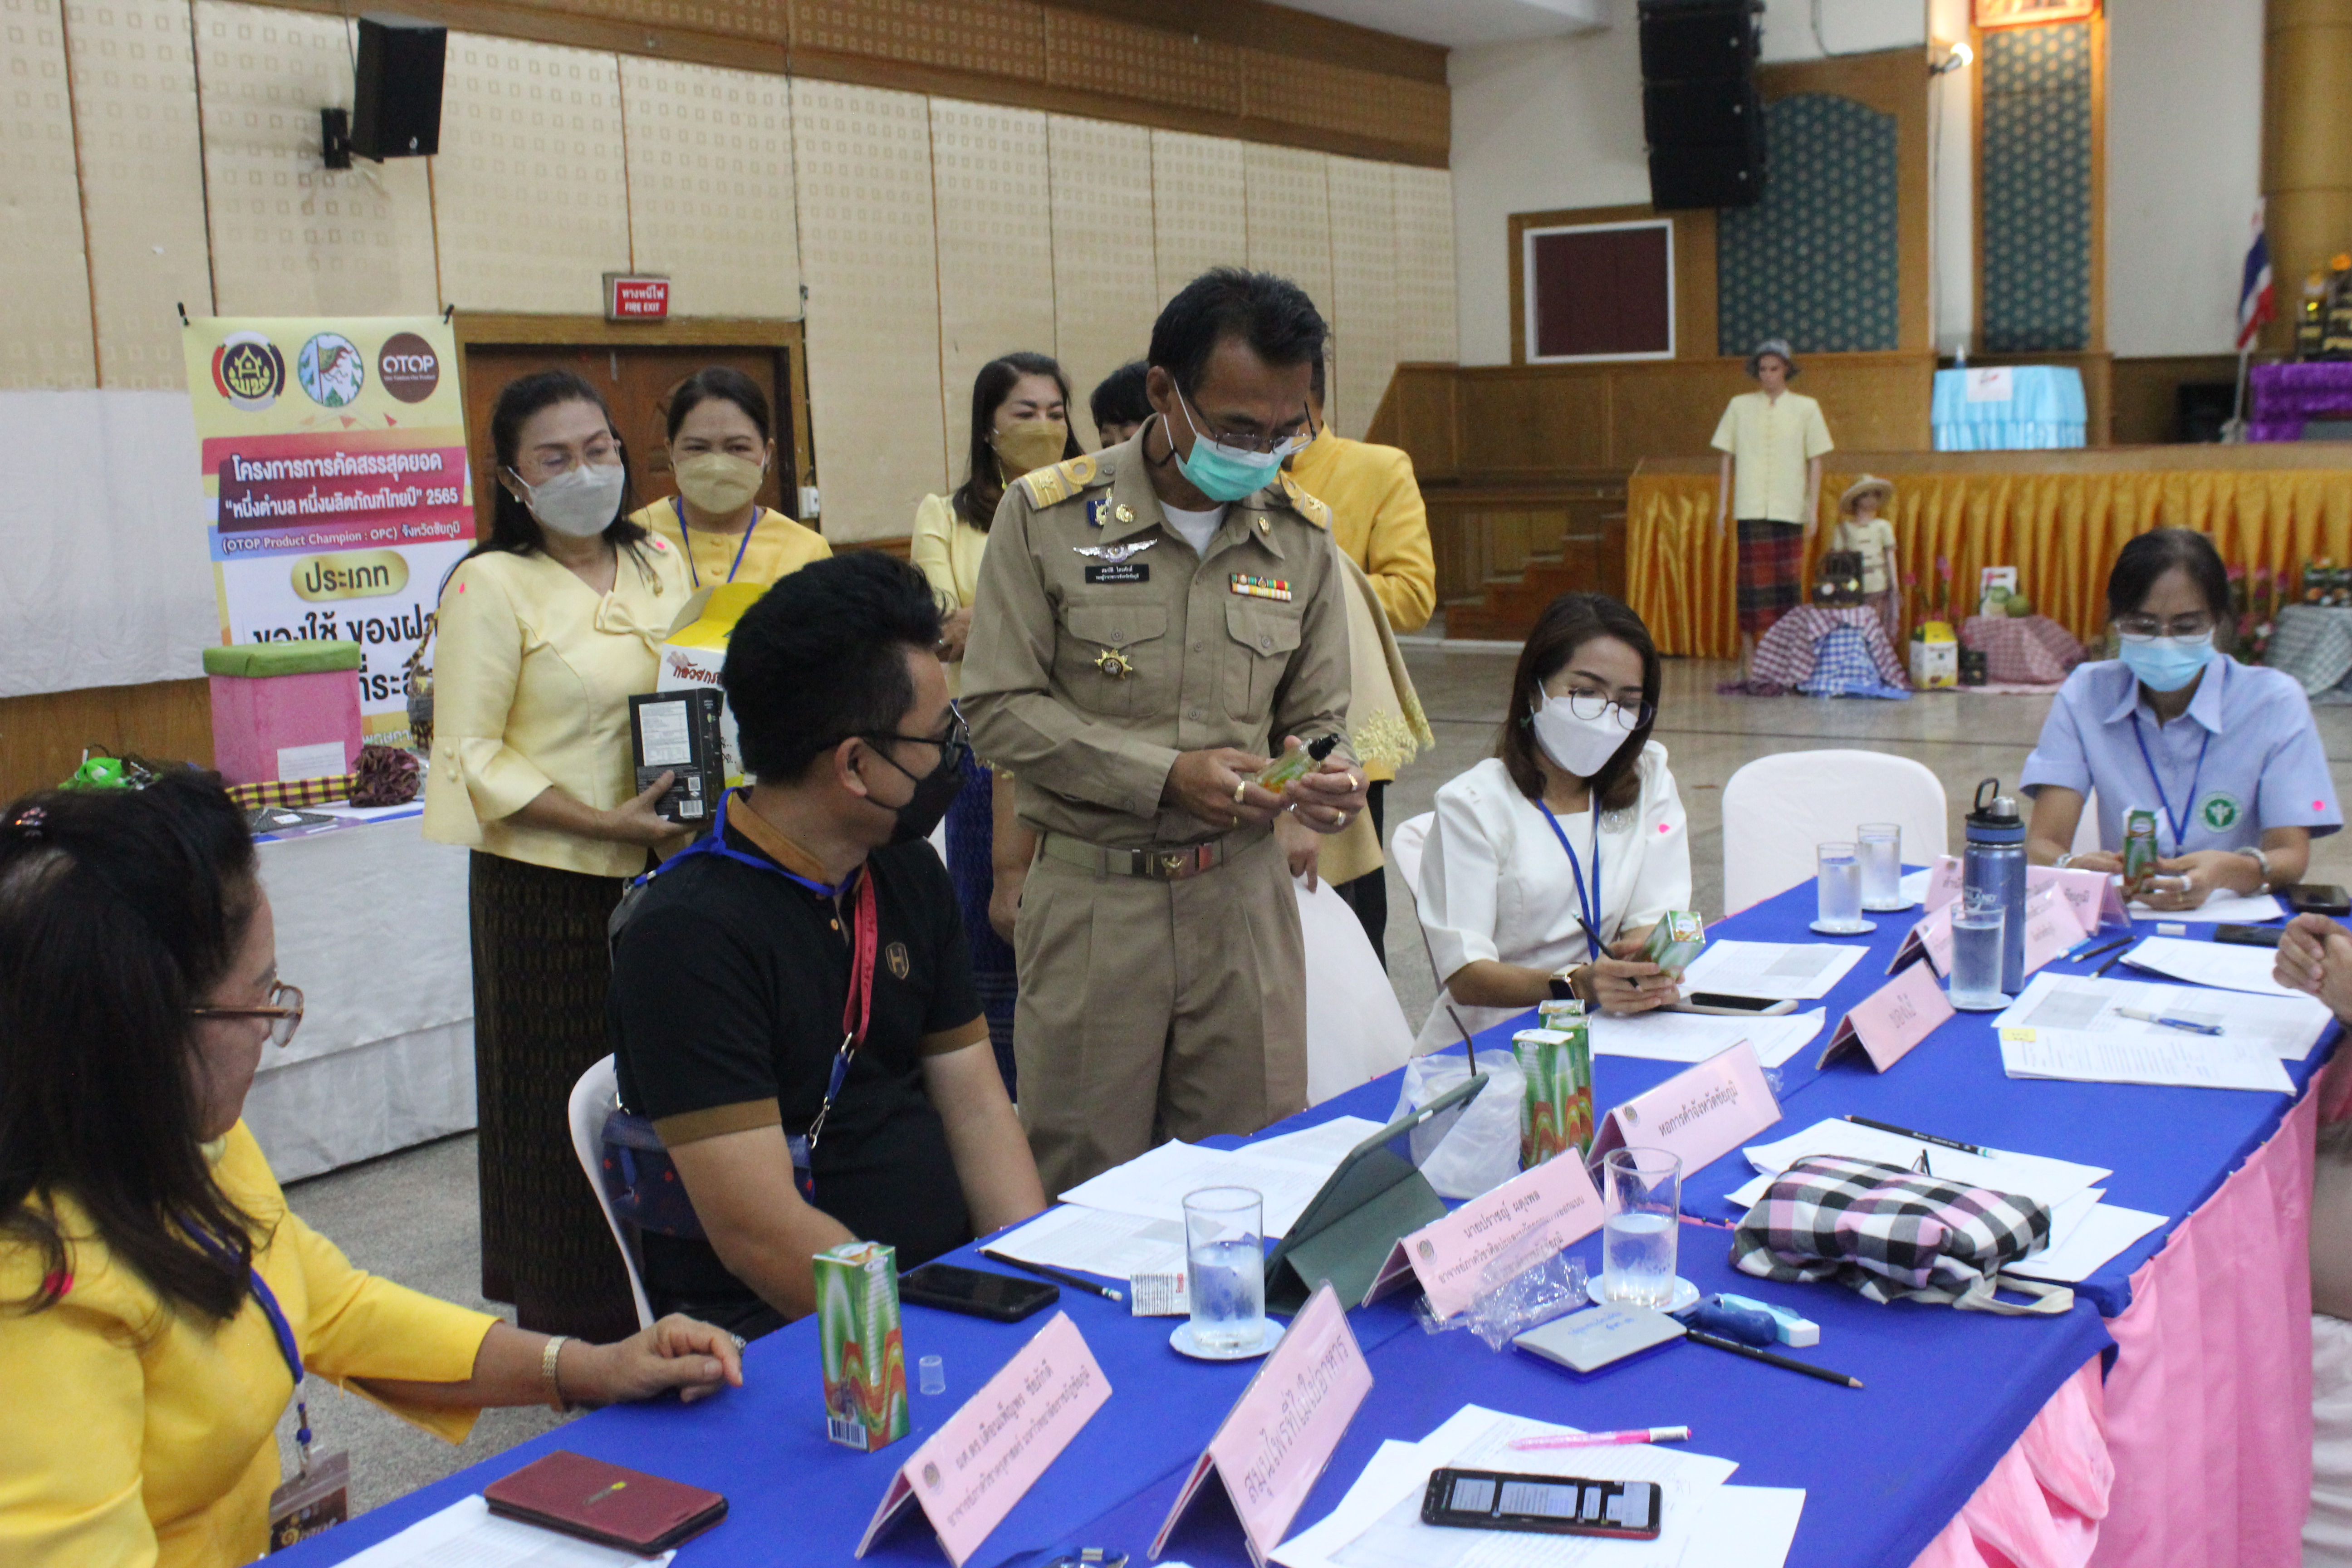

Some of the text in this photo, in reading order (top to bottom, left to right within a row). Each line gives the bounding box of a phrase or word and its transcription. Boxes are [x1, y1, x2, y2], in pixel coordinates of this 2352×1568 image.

[622, 284, 664, 299] ทางหนีไฟ
[625, 302, 660, 312] FIRE EXIT
[382, 355, 434, 372] OTOP
[232, 451, 443, 482] โครงการการคัดสรรสุดยอด
[426, 487, 459, 505] 2565
[222, 537, 261, 554] (OTOP
[264, 535, 306, 549] Product
[309, 531, 362, 546] Champion
[370, 526, 398, 540] OPC)
[305, 562, 389, 593] ประเภท
[346, 603, 438, 645] ของฝา
[673, 662, 722, 686] กล้วยกร
[1658, 1080, 1738, 1137] หอการค้าจังหวัดชัยภูมิ
[1464, 1191, 1540, 1238] นายปราชญ์ ผดุงพล
[1244, 1333, 1348, 1504] สมุนไพรที่ไม่ใช่อาหาร
